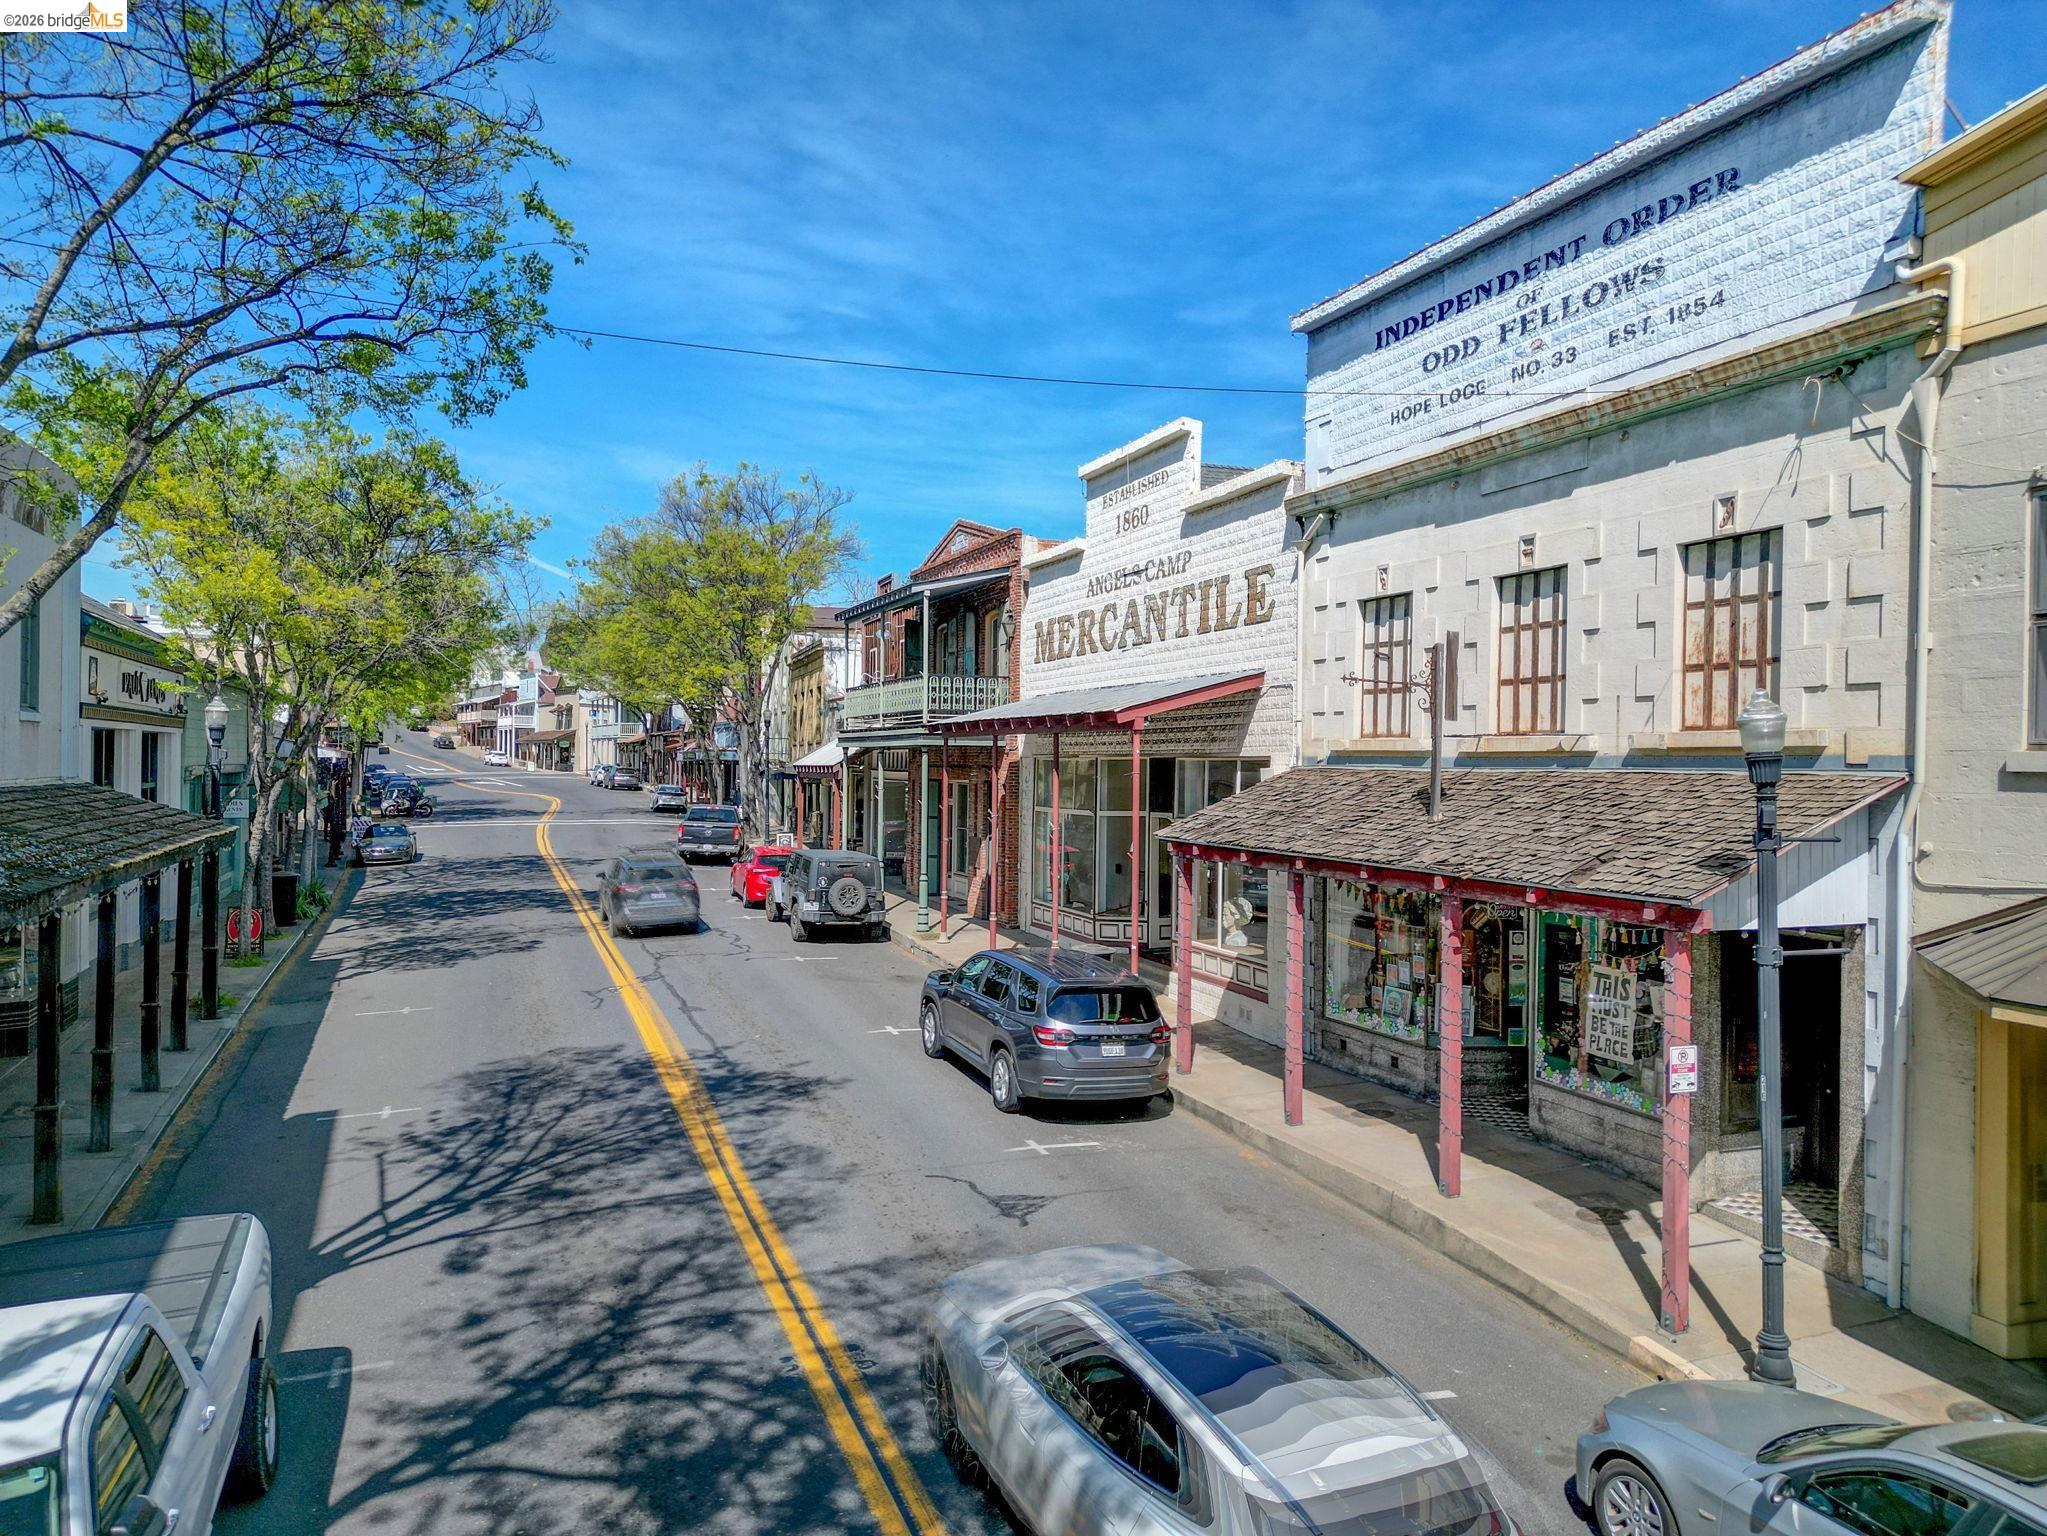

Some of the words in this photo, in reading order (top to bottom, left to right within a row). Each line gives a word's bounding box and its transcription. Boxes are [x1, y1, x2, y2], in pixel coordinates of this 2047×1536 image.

[1375, 234, 1587, 350] INDEPENDENT
[1602, 166, 1741, 246] ORDER
[1422, 335, 1482, 374] ODD
[1498, 257, 1666, 345] FELLOWS
[1516, 286, 1544, 309] OF
[1390, 398, 1433, 426] HOPE
[1511, 359, 1545, 383] NO.
[1551, 345, 1578, 370] 33
[1608, 315, 1656, 349] EST.
[1668, 288, 1727, 326] 1854
[1102, 469, 1170, 510] ESTABLISHED
[1115, 504, 1150, 535] 1860
[1086, 563, 1142, 598] ANGELS
[1144, 549, 1193, 583] CAMP
[1034, 563, 1276, 664] MERCANTILE
[1488, 903, 1517, 919] Open
[1593, 971, 1632, 1001] THIS
[1590, 1014, 1607, 1035] BE
[1610, 1021, 1630, 1039] THE
[1589, 1033, 1629, 1059] PLACE
